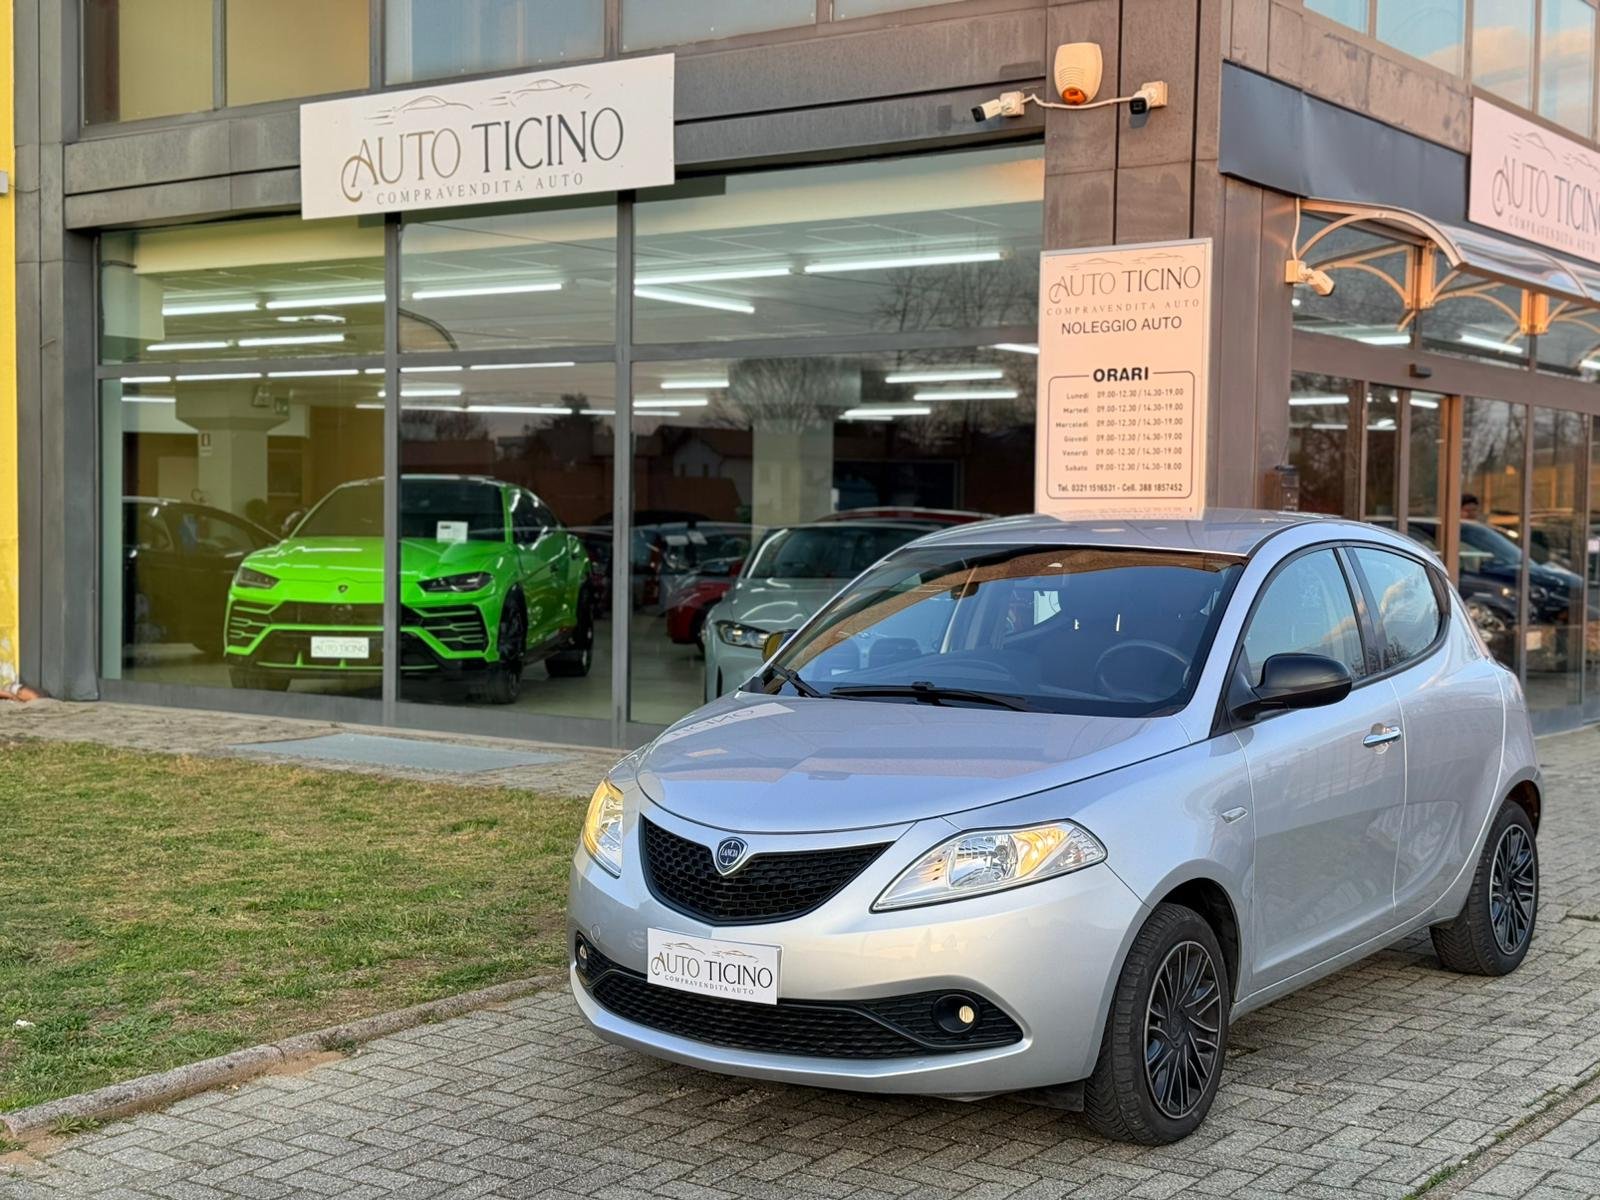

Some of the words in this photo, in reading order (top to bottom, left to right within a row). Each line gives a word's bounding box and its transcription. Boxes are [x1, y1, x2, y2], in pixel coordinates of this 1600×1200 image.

[341, 128, 461, 202] AUTO
[471, 107, 624, 173] TICINO
[376, 179, 523, 205] COMPRAVENDITA
[536, 172, 584, 189] AUTO
[1492, 154, 1550, 217] AUTO
[1554, 175, 1600, 236] TICIN
[1049, 272, 1116, 304] AUTO
[1122, 265, 1201, 292] TICINO
[1046, 302, 1155, 316] COMPRAVENDITA
[1166, 299, 1199, 309] AUTO
[1061, 318, 1137, 335] NOLEGGIO
[1141, 316, 1182, 330] AUTO
[1093, 367, 1149, 382] ORARI
[651, 952, 700, 978] AUTO
[704, 960, 773, 988] TICINO
[664, 974, 729, 992] COMPRAVENDITA
[731, 985, 754, 996] AUTO
